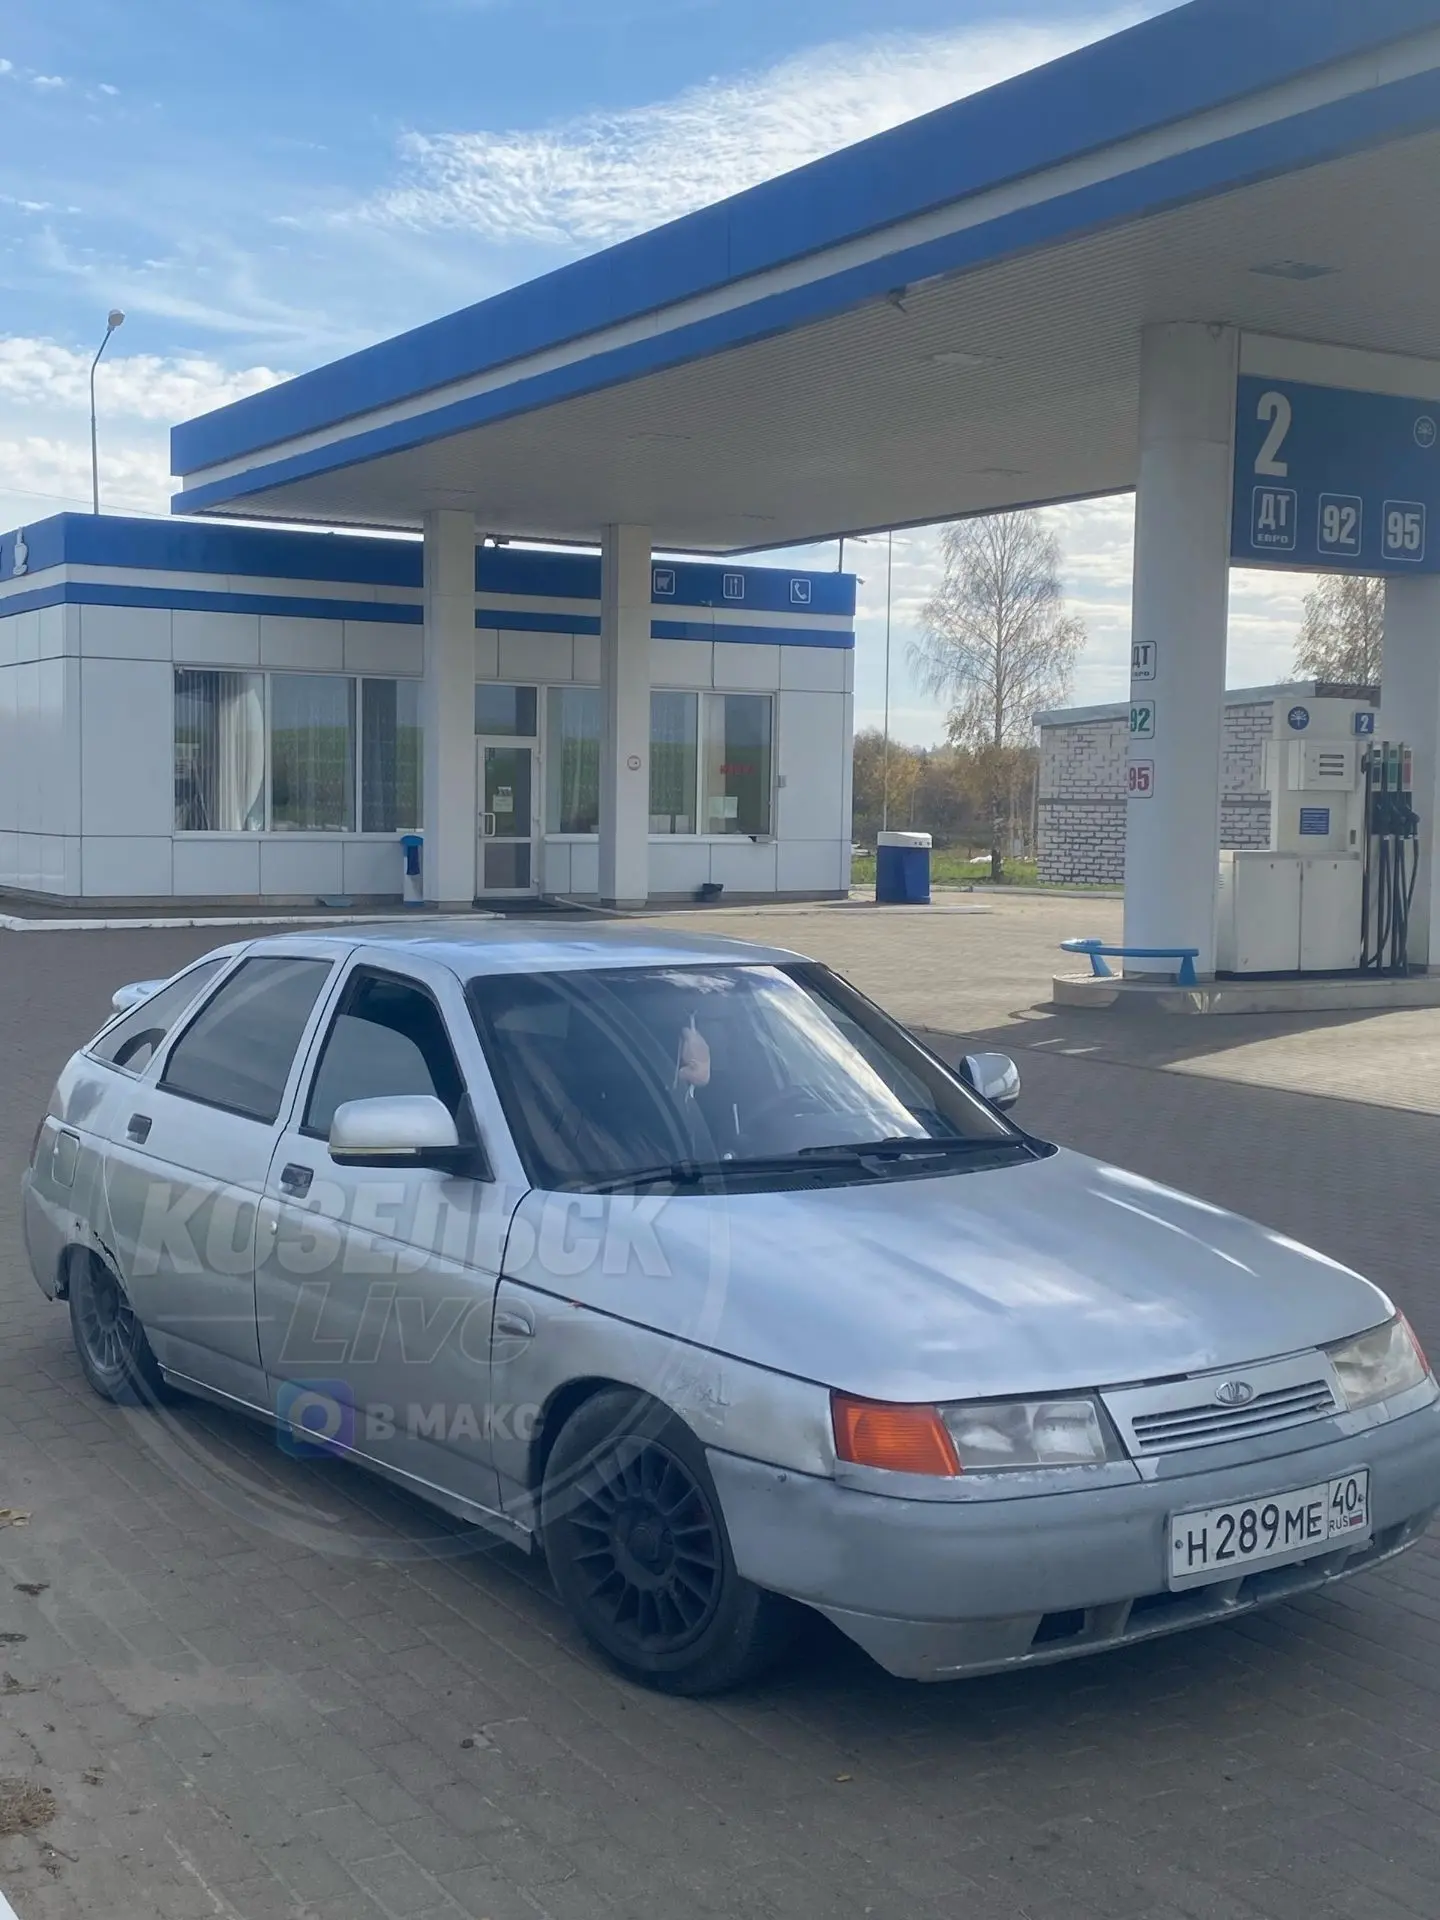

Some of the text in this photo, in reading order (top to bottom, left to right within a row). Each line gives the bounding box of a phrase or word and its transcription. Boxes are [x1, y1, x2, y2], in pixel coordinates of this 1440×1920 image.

[1254, 390, 1292, 478] 2
[1258, 493, 1291, 530] ДТ
[1322, 504, 1357, 545] 92
[1386, 511, 1421, 550] 95
[1360, 714, 1370, 732] 2
[1128, 767, 1150, 791] 95
[1332, 1478, 1358, 1514] 40
[1329, 1515, 1349, 1531] RUS
